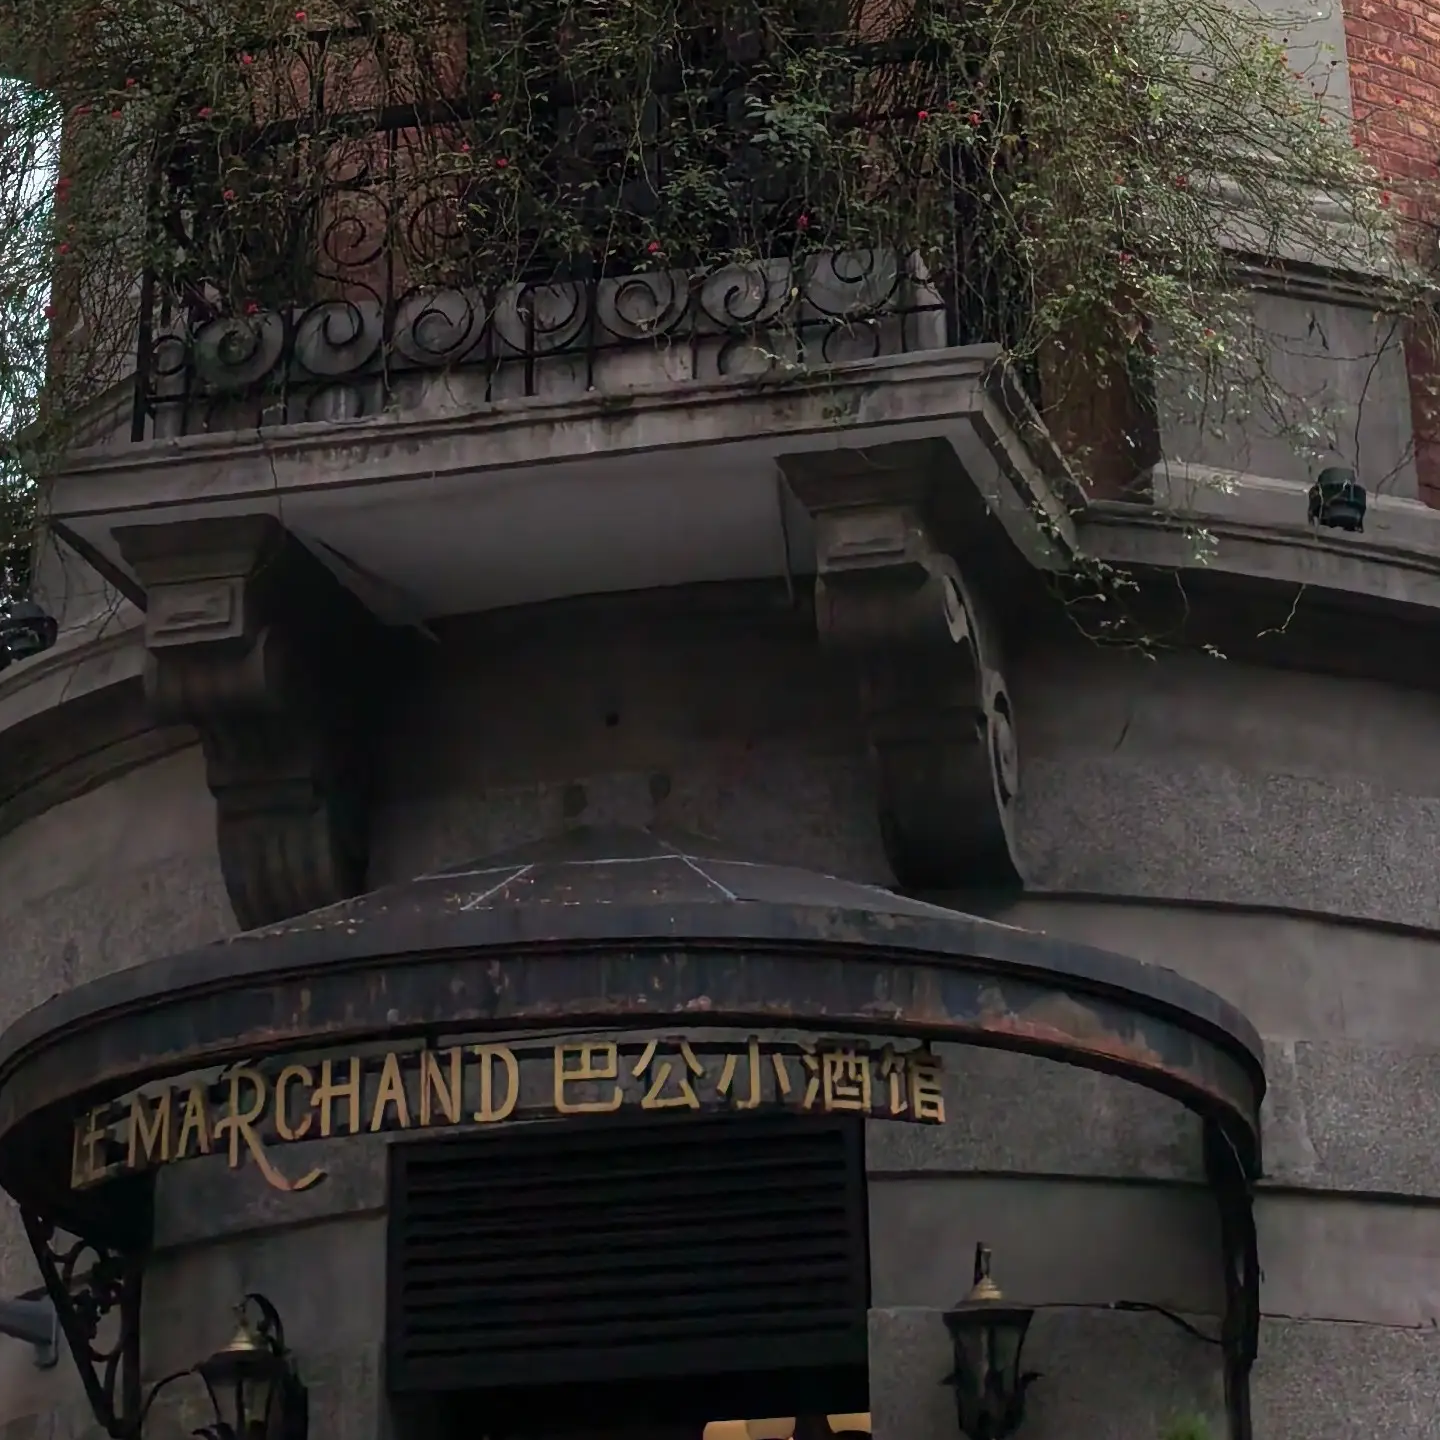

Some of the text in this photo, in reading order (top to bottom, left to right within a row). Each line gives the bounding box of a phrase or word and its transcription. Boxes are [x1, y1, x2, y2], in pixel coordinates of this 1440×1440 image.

[127, 1043, 520, 1191] MARCHAND
[553, 1034, 946, 1125] 巴公小酒馆
